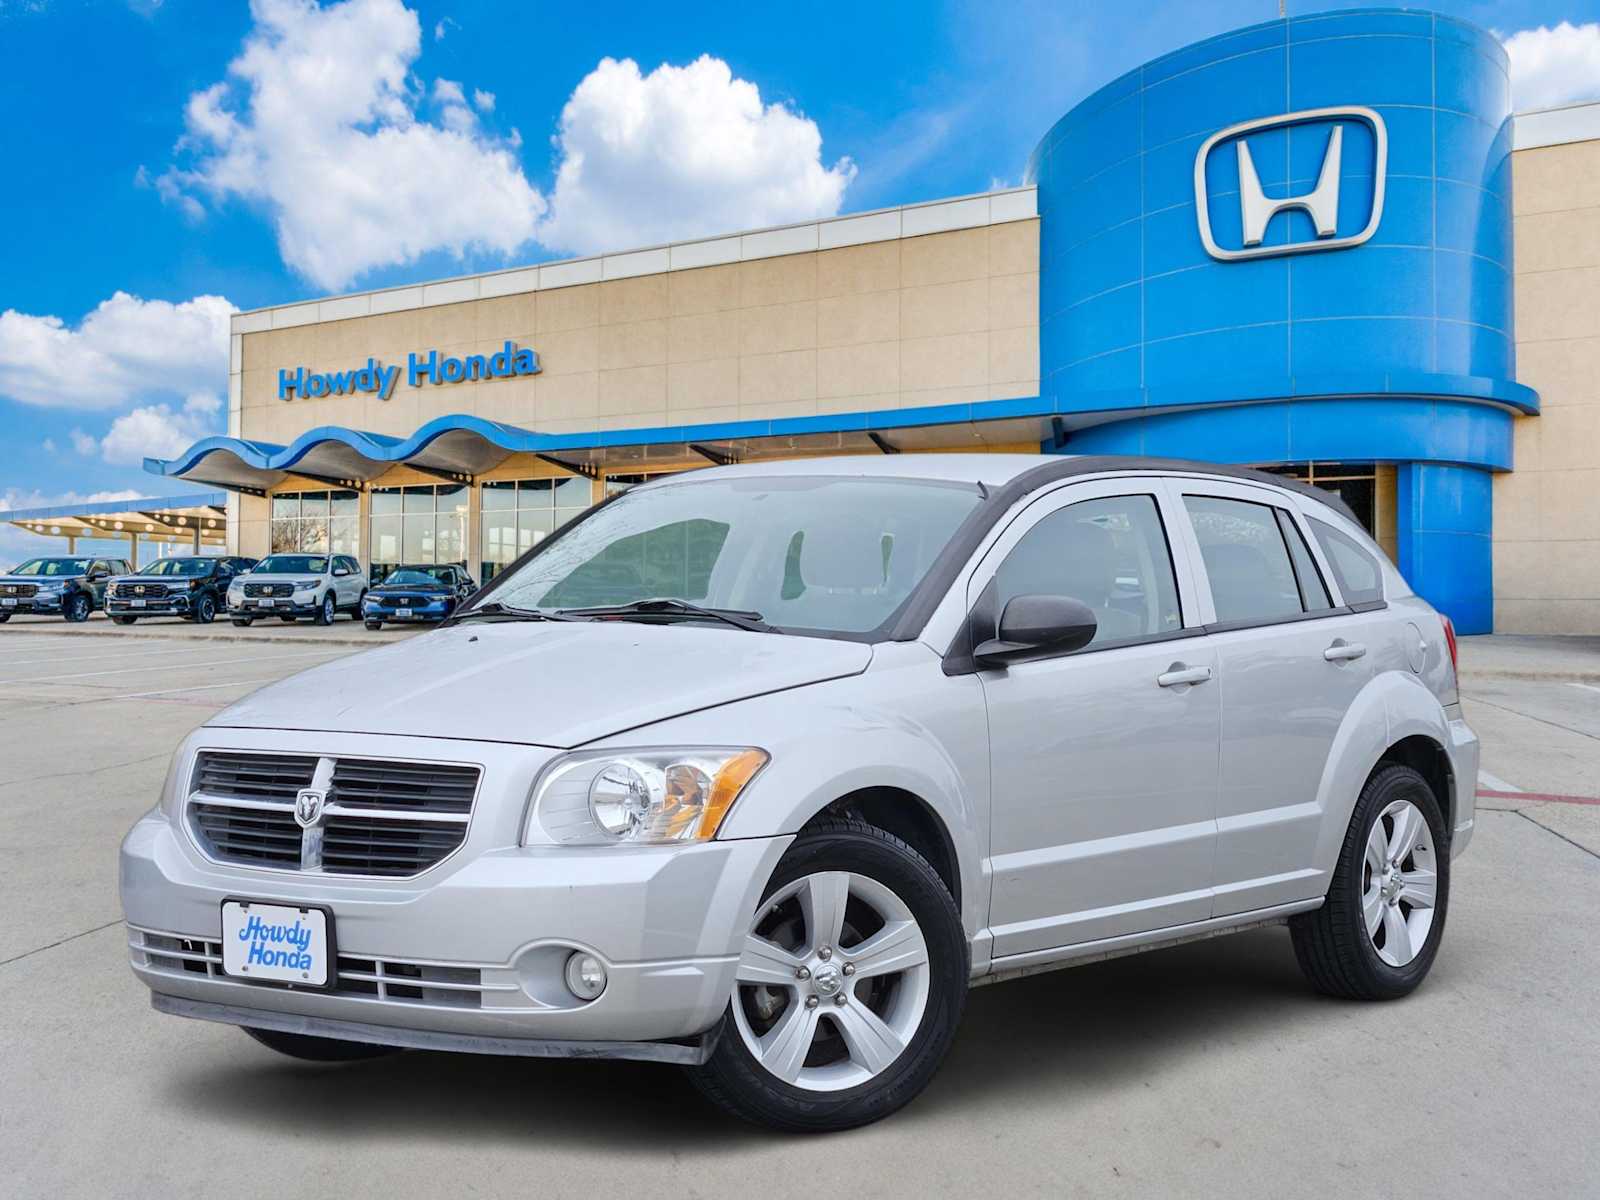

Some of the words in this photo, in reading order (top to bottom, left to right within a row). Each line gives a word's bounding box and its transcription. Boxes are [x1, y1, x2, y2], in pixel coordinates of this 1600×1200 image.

[278, 357, 400, 401] Howdy
[408, 340, 541, 387] Honda
[239, 916, 311, 951] Howdy
[248, 941, 312, 970] Honda
